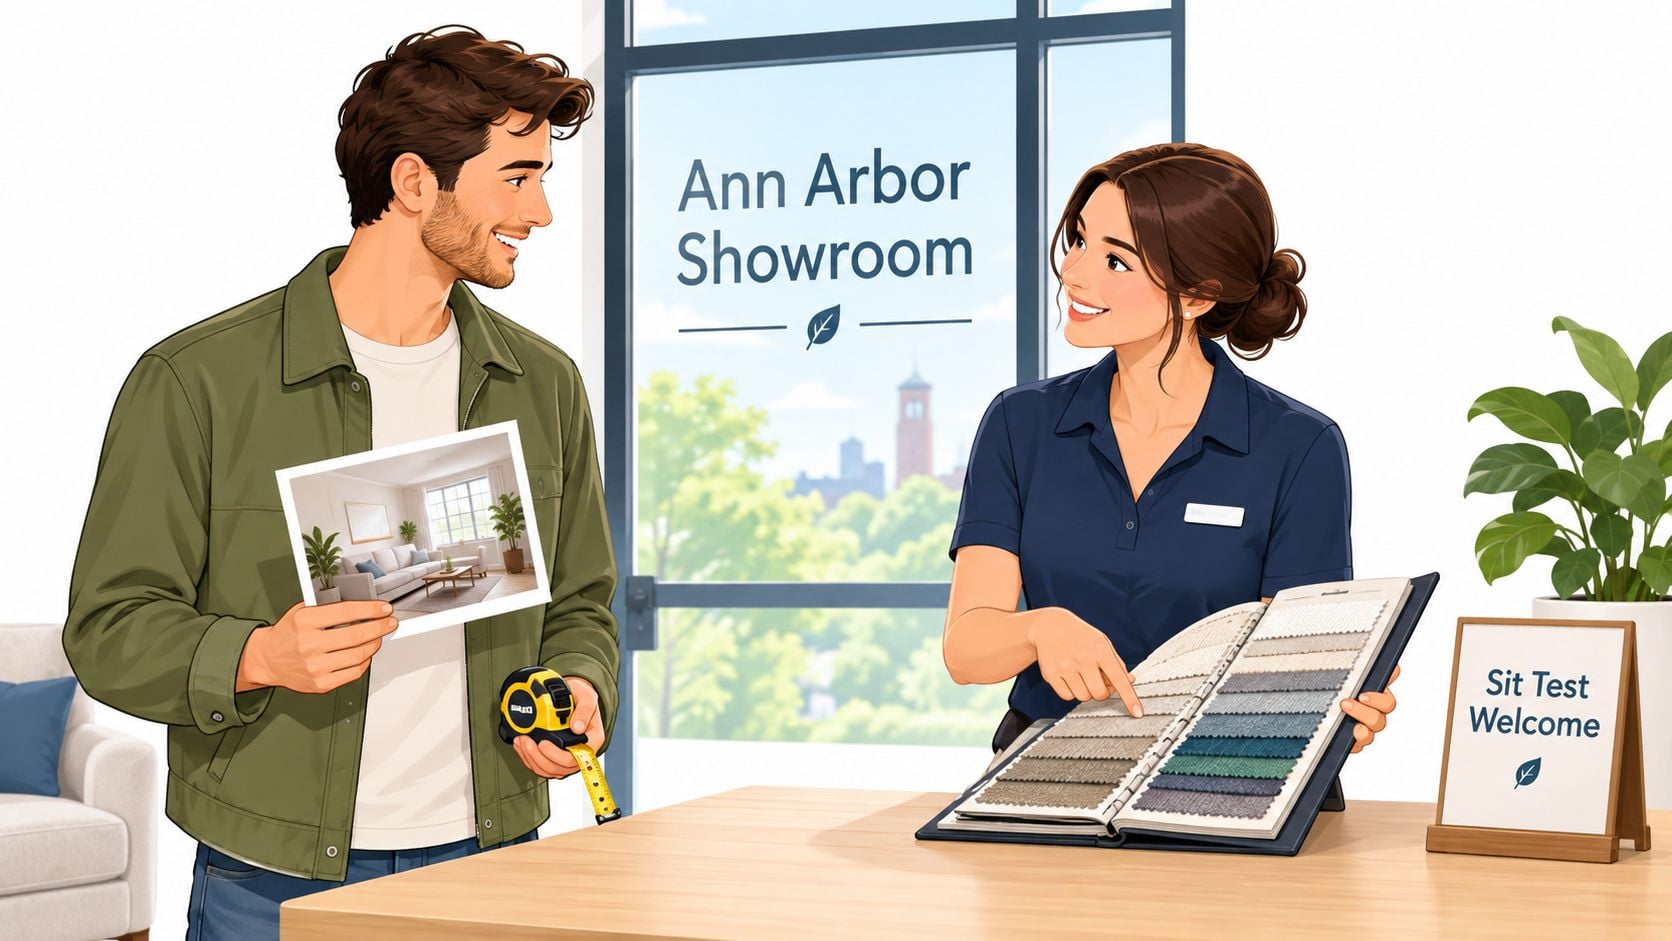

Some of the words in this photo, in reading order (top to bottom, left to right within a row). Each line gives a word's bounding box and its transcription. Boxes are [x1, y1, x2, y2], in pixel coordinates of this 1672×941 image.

[678, 159, 786, 211] Ann
[804, 147, 971, 206] Arbor
[677, 229, 972, 286] Showroom
[1486, 668, 1524, 696] Sit
[1532, 670, 1590, 699] Test
[1469, 706, 1600, 738] Welcome
